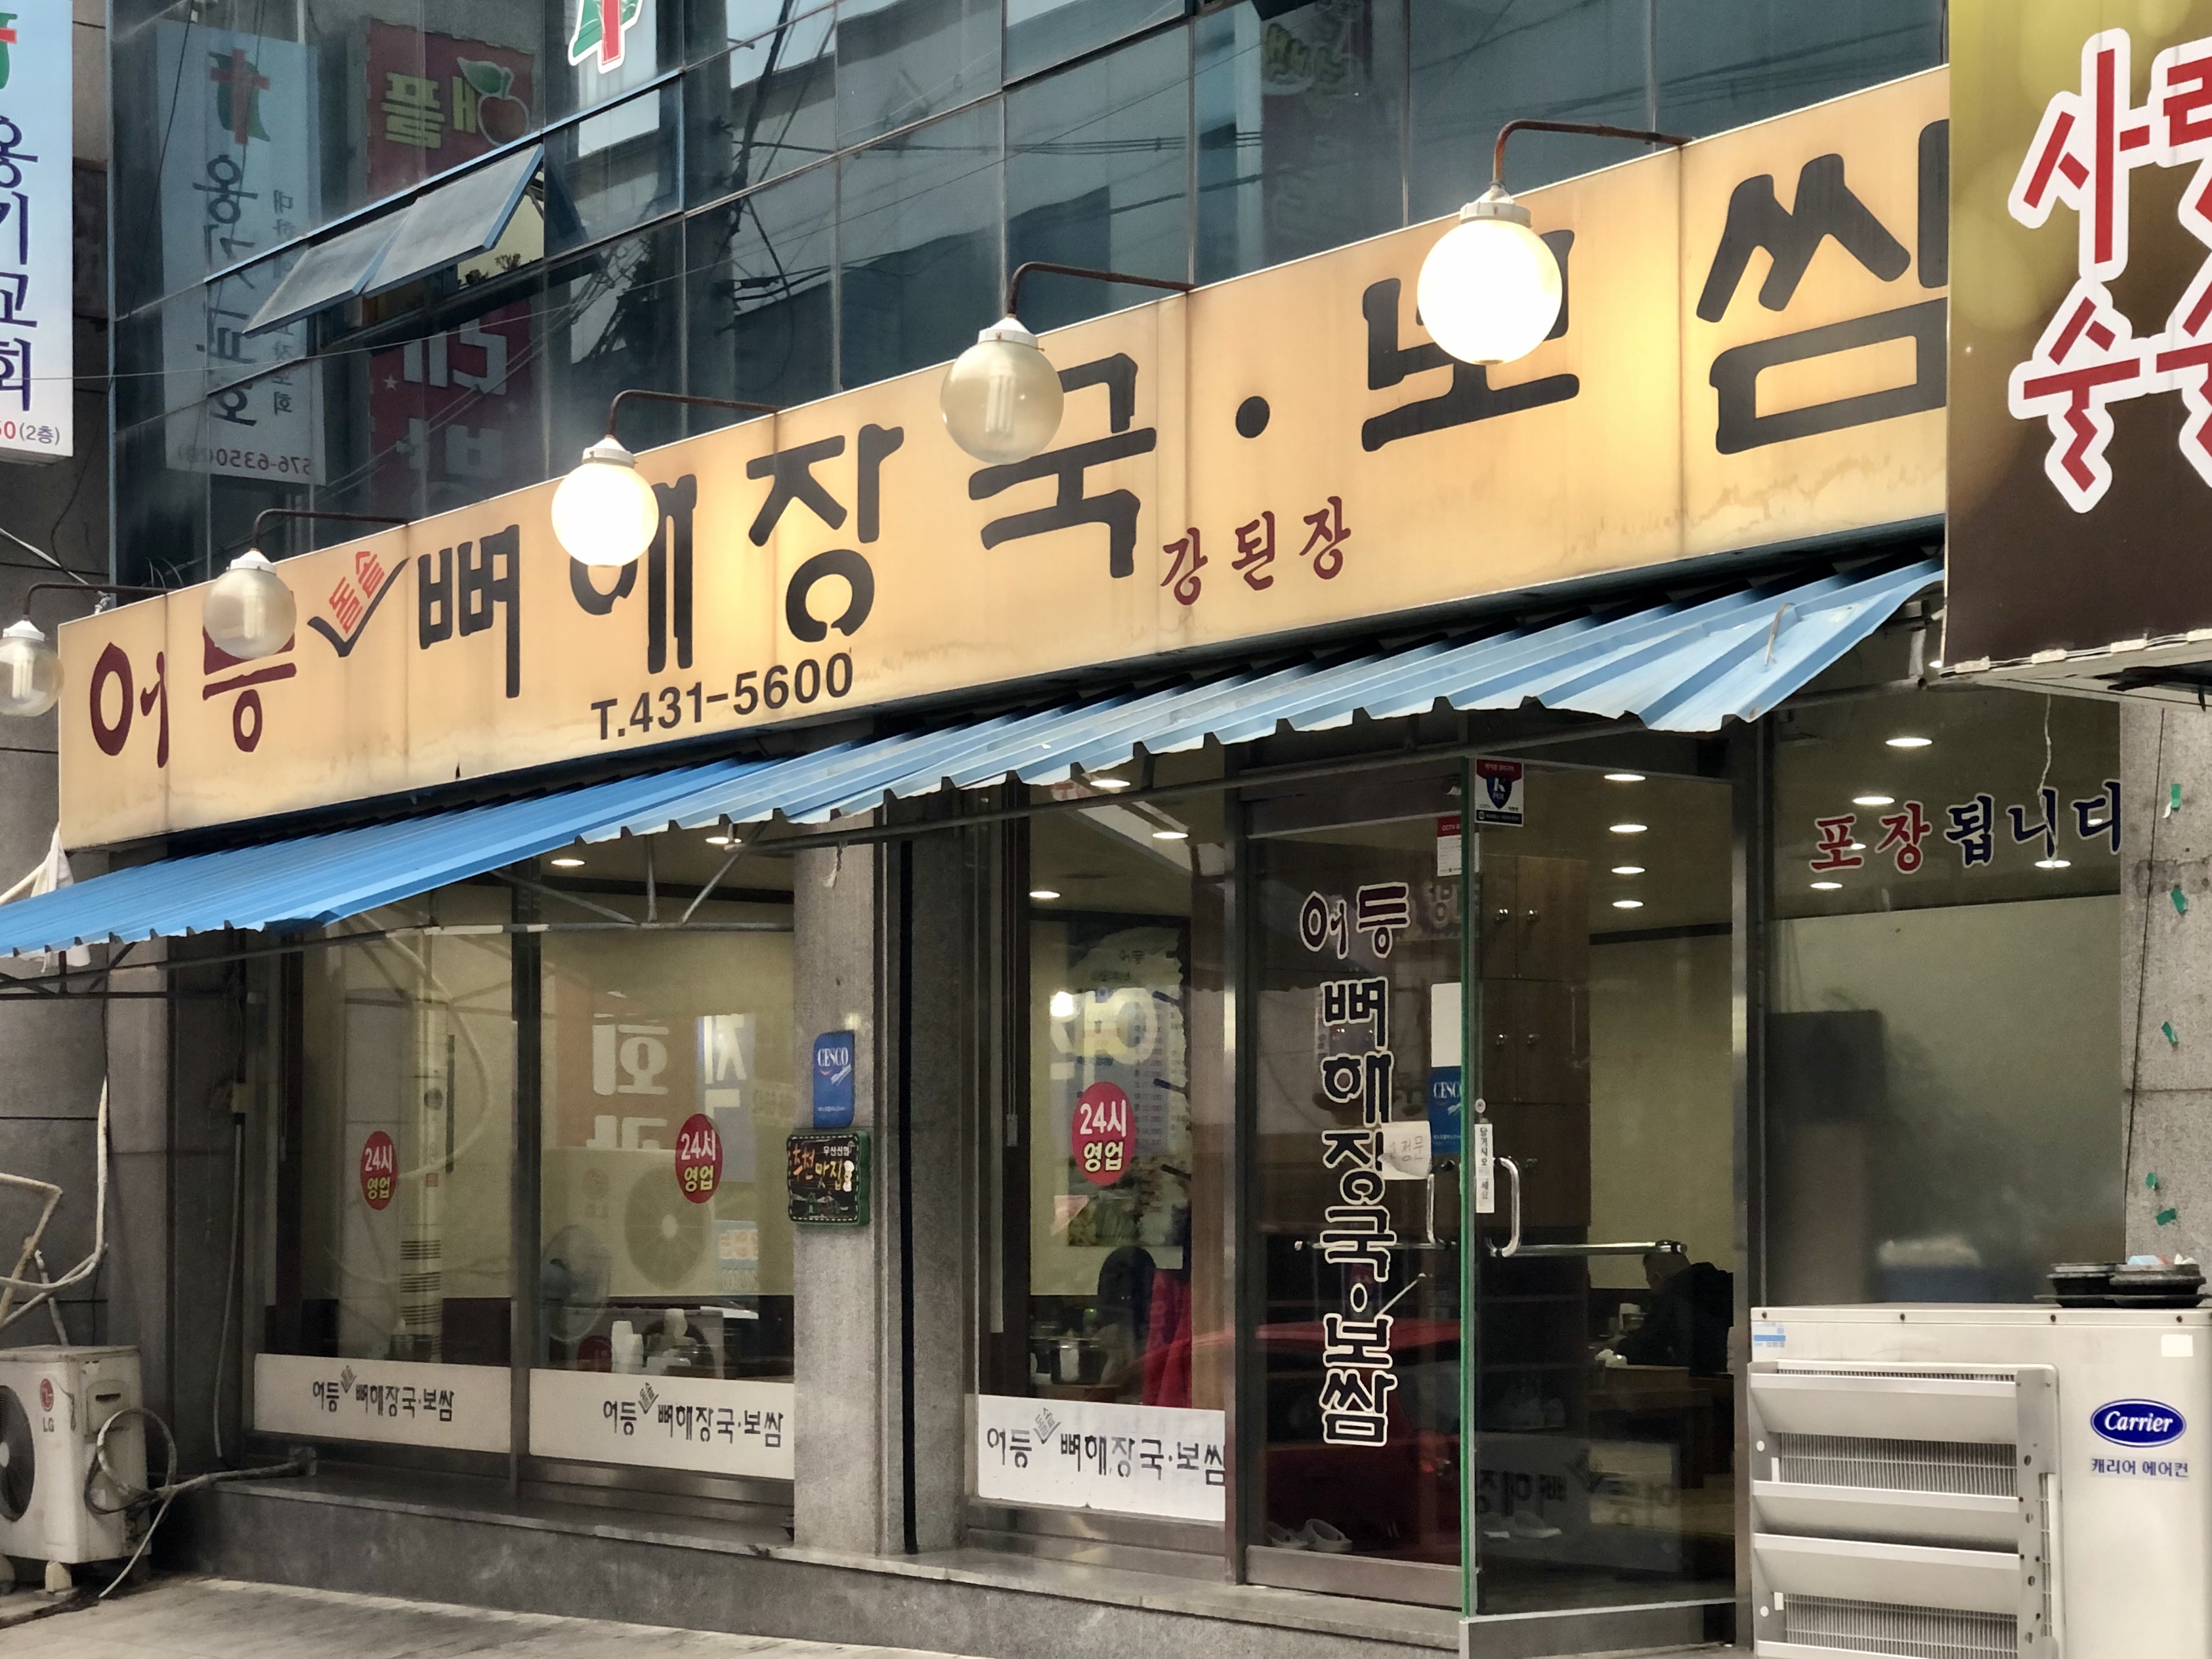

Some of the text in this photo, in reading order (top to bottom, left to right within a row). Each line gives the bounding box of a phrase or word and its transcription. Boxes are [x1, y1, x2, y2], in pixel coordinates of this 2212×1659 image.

[1160, 496, 1351, 606] 강된장
[591, 652, 853, 740] T.431-5600
[1300, 882, 1410, 959] 어등
[817, 1047, 849, 1067] CESCO
[1434, 1082, 1461, 1099] CESC
[1080, 1099, 1126, 1137] 24시
[365, 1144, 393, 1173] 24시
[681, 1129, 716, 1161] 24시
[1084, 1142, 1124, 1173] 영업
[368, 1177, 391, 1200] 영업
[684, 1166, 714, 1192] 영업
[815, 1159, 842, 1190] 맛집
[312, 1381, 339, 1412] 어등
[43, 1417, 54, 1433] LG
[603, 1400, 637, 1436] 어등
[2104, 1410, 2174, 1433] Carrier
[987, 1427, 1032, 1469] 어등
[2091, 1458, 2189, 1479] 캐리어 에어컨
